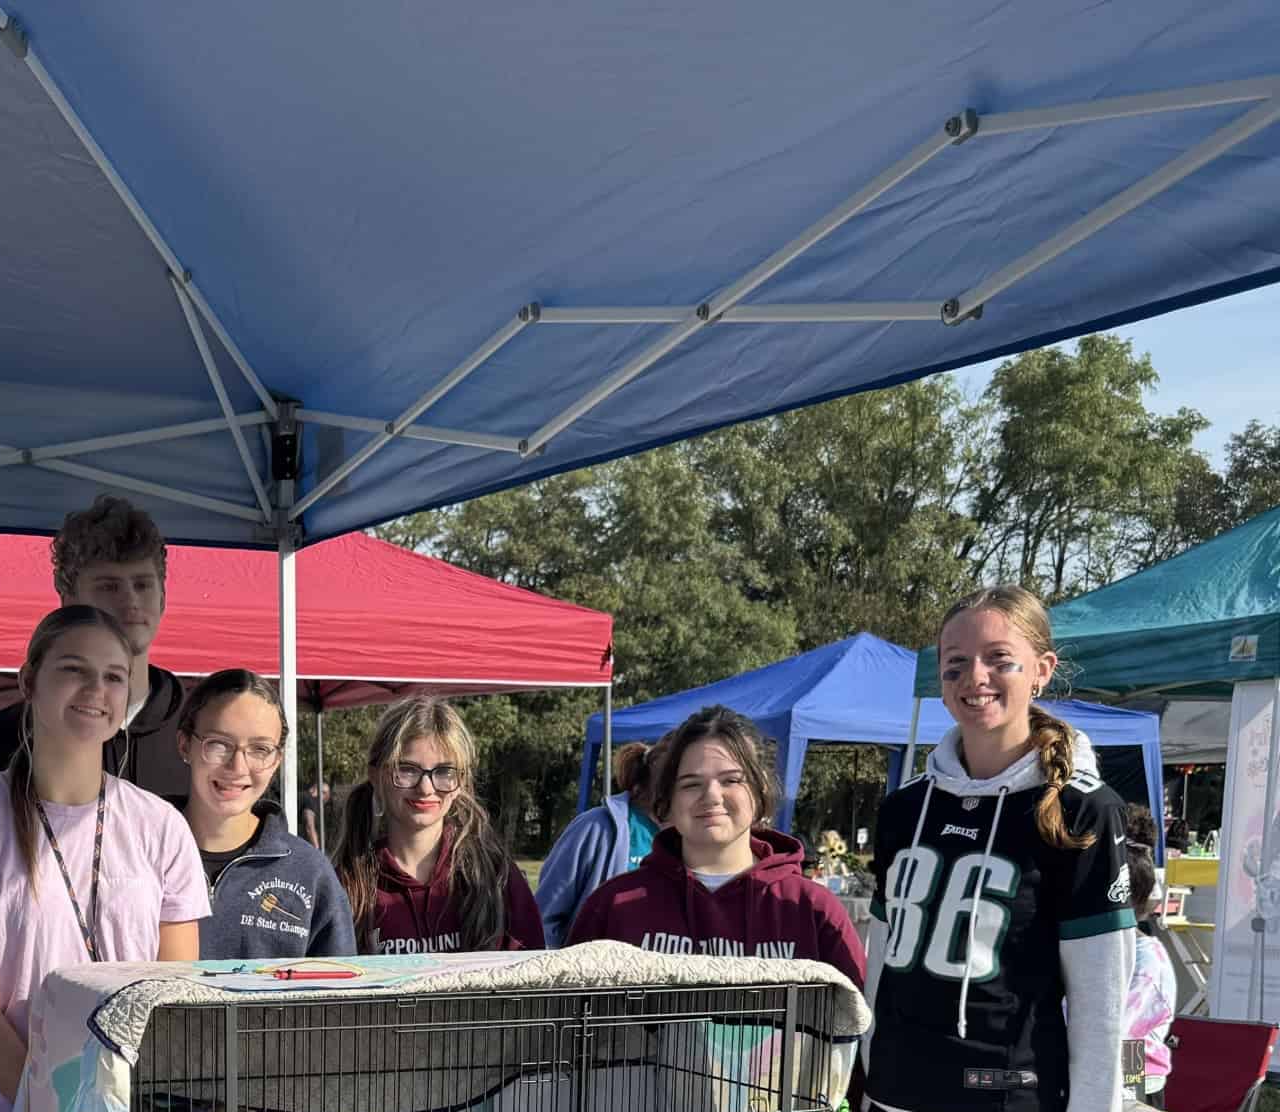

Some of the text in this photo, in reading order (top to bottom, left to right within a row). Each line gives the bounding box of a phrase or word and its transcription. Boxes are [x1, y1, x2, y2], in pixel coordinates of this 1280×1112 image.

[247, 876, 312, 910] Agricultural Sales
[240, 914, 255, 926] DE
[256, 916, 277, 930] State
[884, 846, 1017, 981] 86
